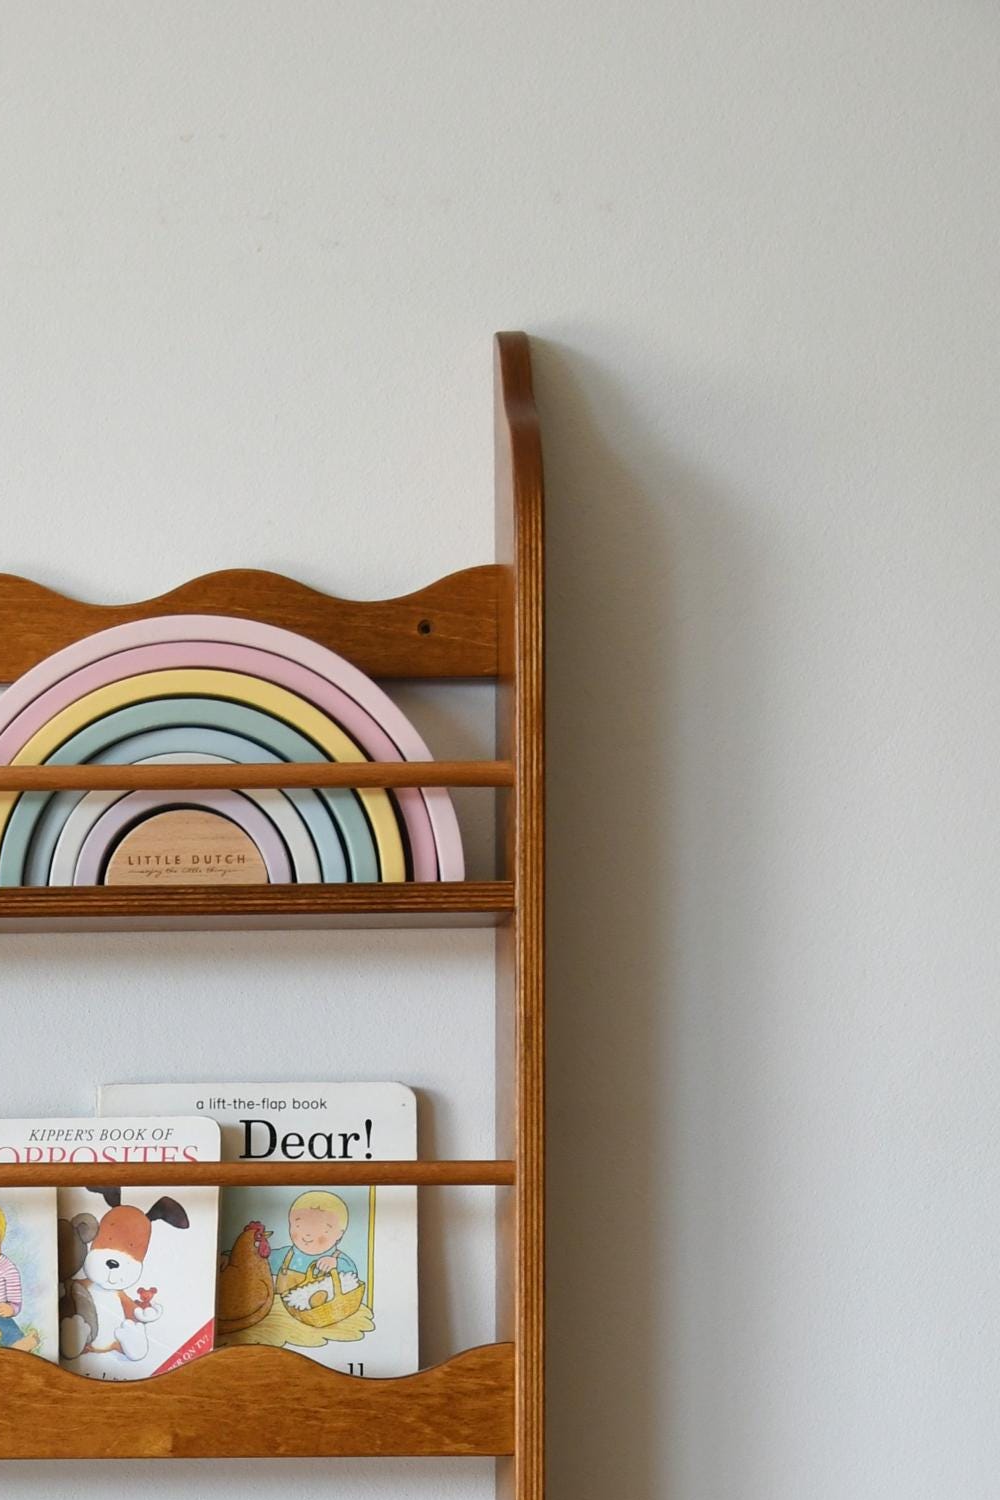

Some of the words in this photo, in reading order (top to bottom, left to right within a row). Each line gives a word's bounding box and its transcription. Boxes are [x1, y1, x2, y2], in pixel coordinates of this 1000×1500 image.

[128, 855, 181, 866] LITTLE
[191, 854, 246, 865] DUTCH
[196, 1099, 204, 1110] a
[209, 1098, 287, 1111] lift-the-flap
[292, 1098, 328, 1110] book
[28, 1129, 94, 1142] KIPPER'S
[99, 1128, 147, 1142] BOOK
[151, 1127, 175, 1141] OF
[239, 1118, 373, 1160] Dear!
[182, 1345, 196, 1360] ON
